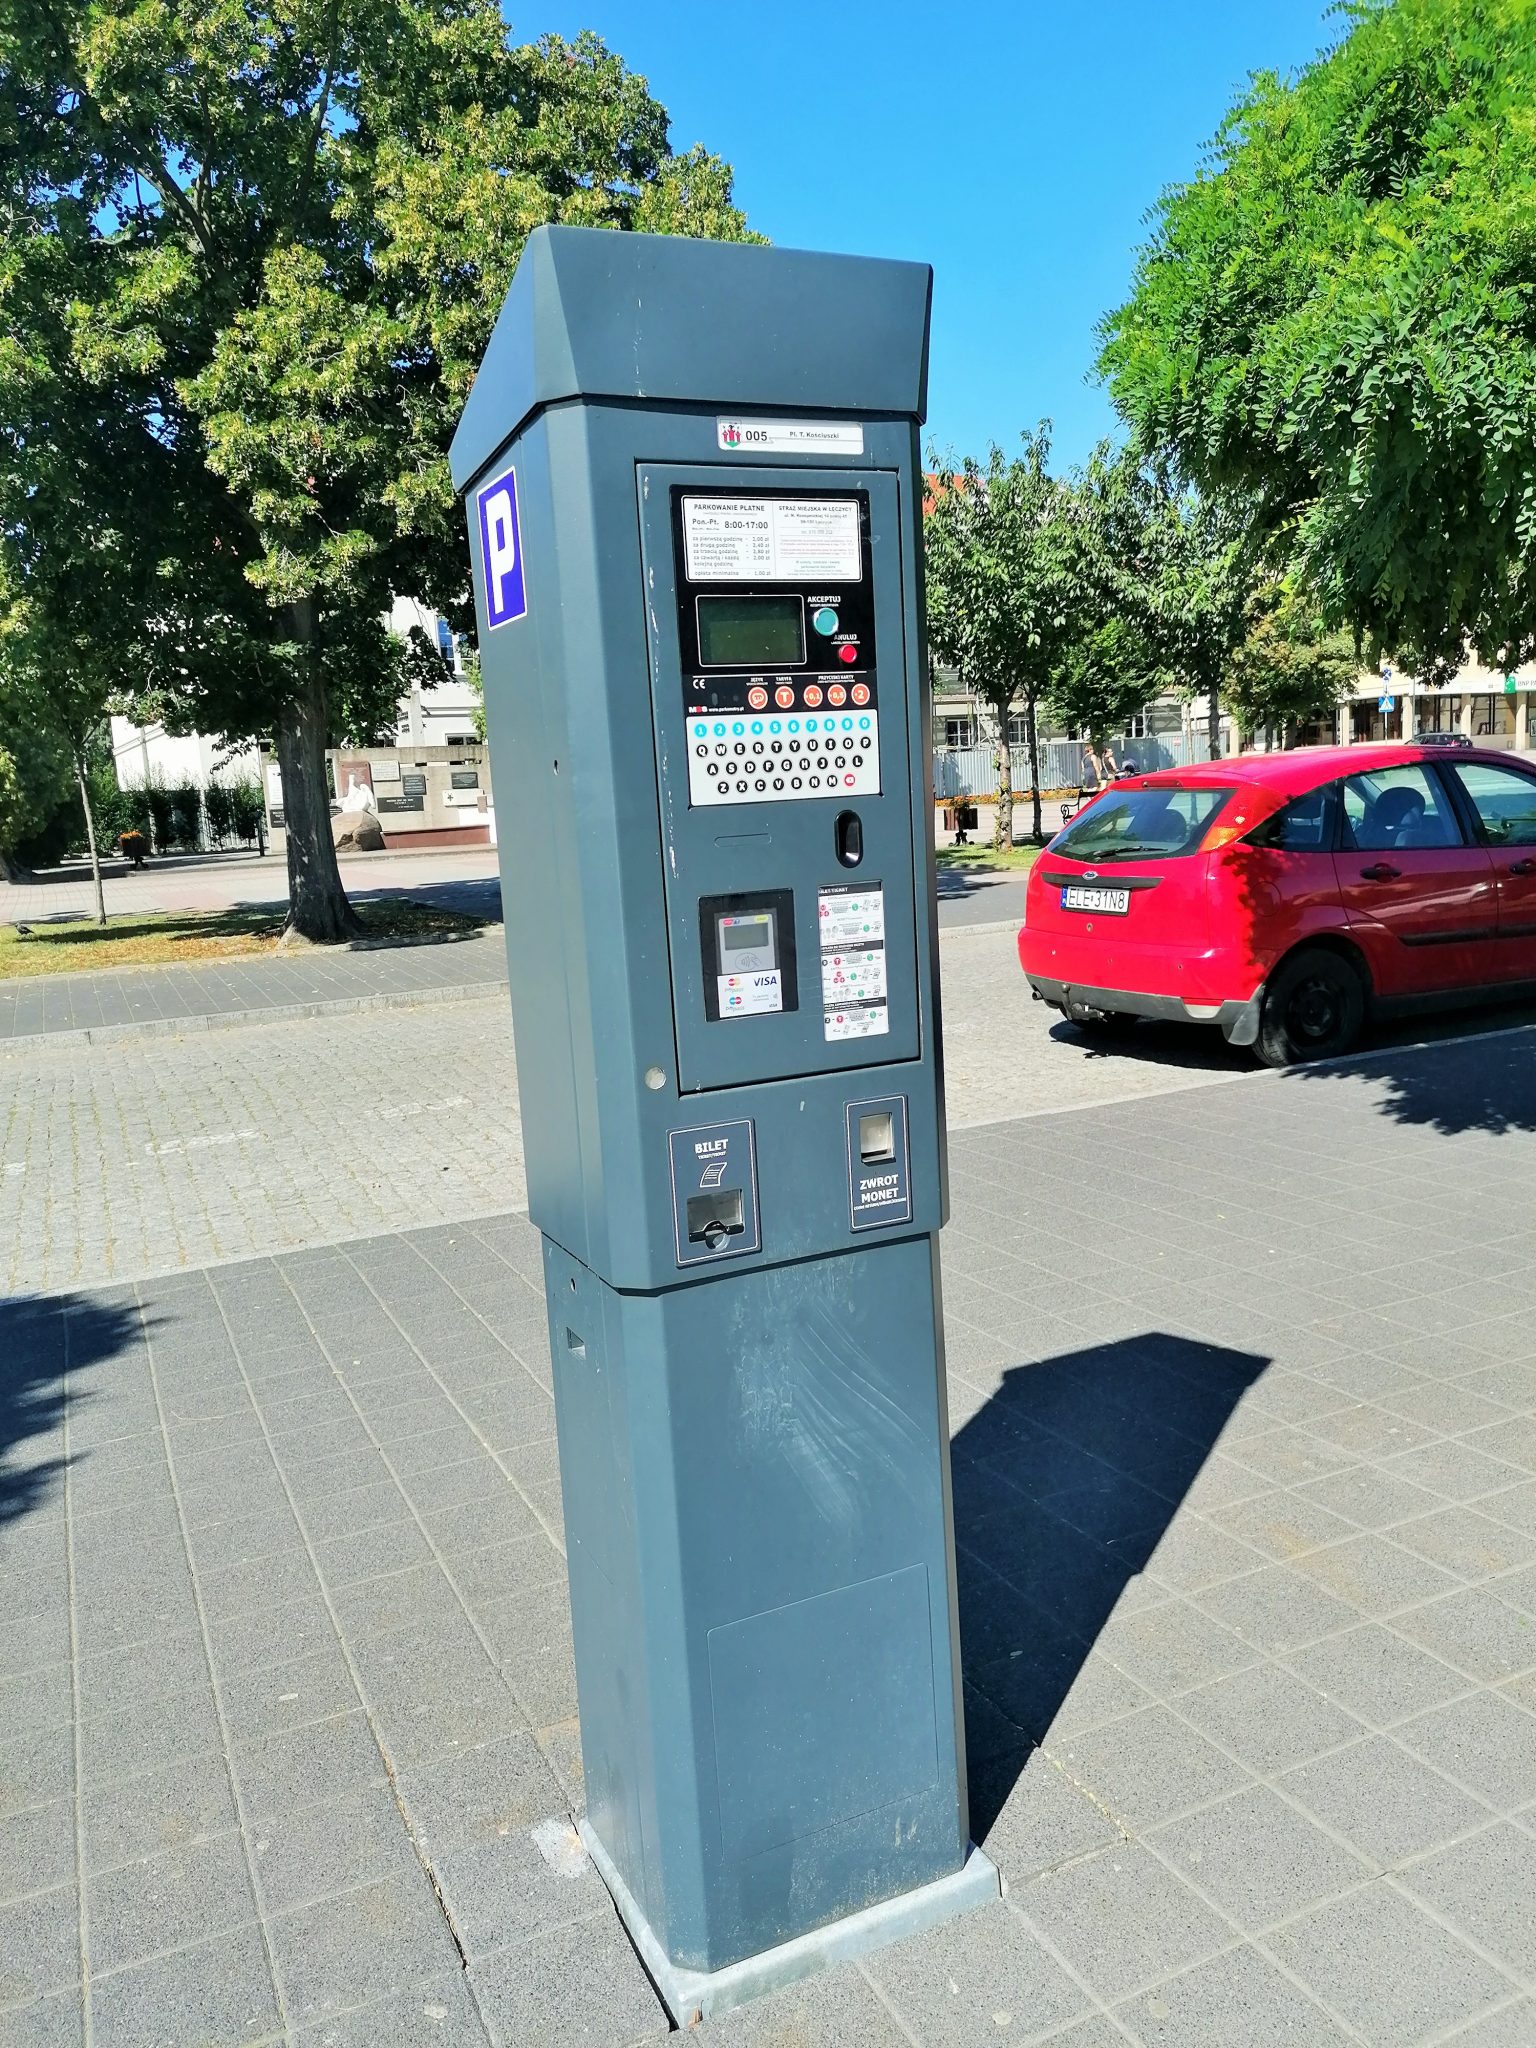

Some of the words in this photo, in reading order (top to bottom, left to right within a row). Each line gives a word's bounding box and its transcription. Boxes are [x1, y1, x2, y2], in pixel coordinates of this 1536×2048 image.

[745, 430, 768, 441] 005
[694, 503, 738, 511] PARKOWANIE
[724, 521, 769, 529] 8:00-17:00
[485, 489, 515, 615] P
[692, 678, 706, 689] CE
[753, 976, 778, 987] VISA
[694, 1139, 729, 1154] BILET
[859, 1174, 899, 1190] ZWROT
[861, 1187, 899, 1204] MONET
